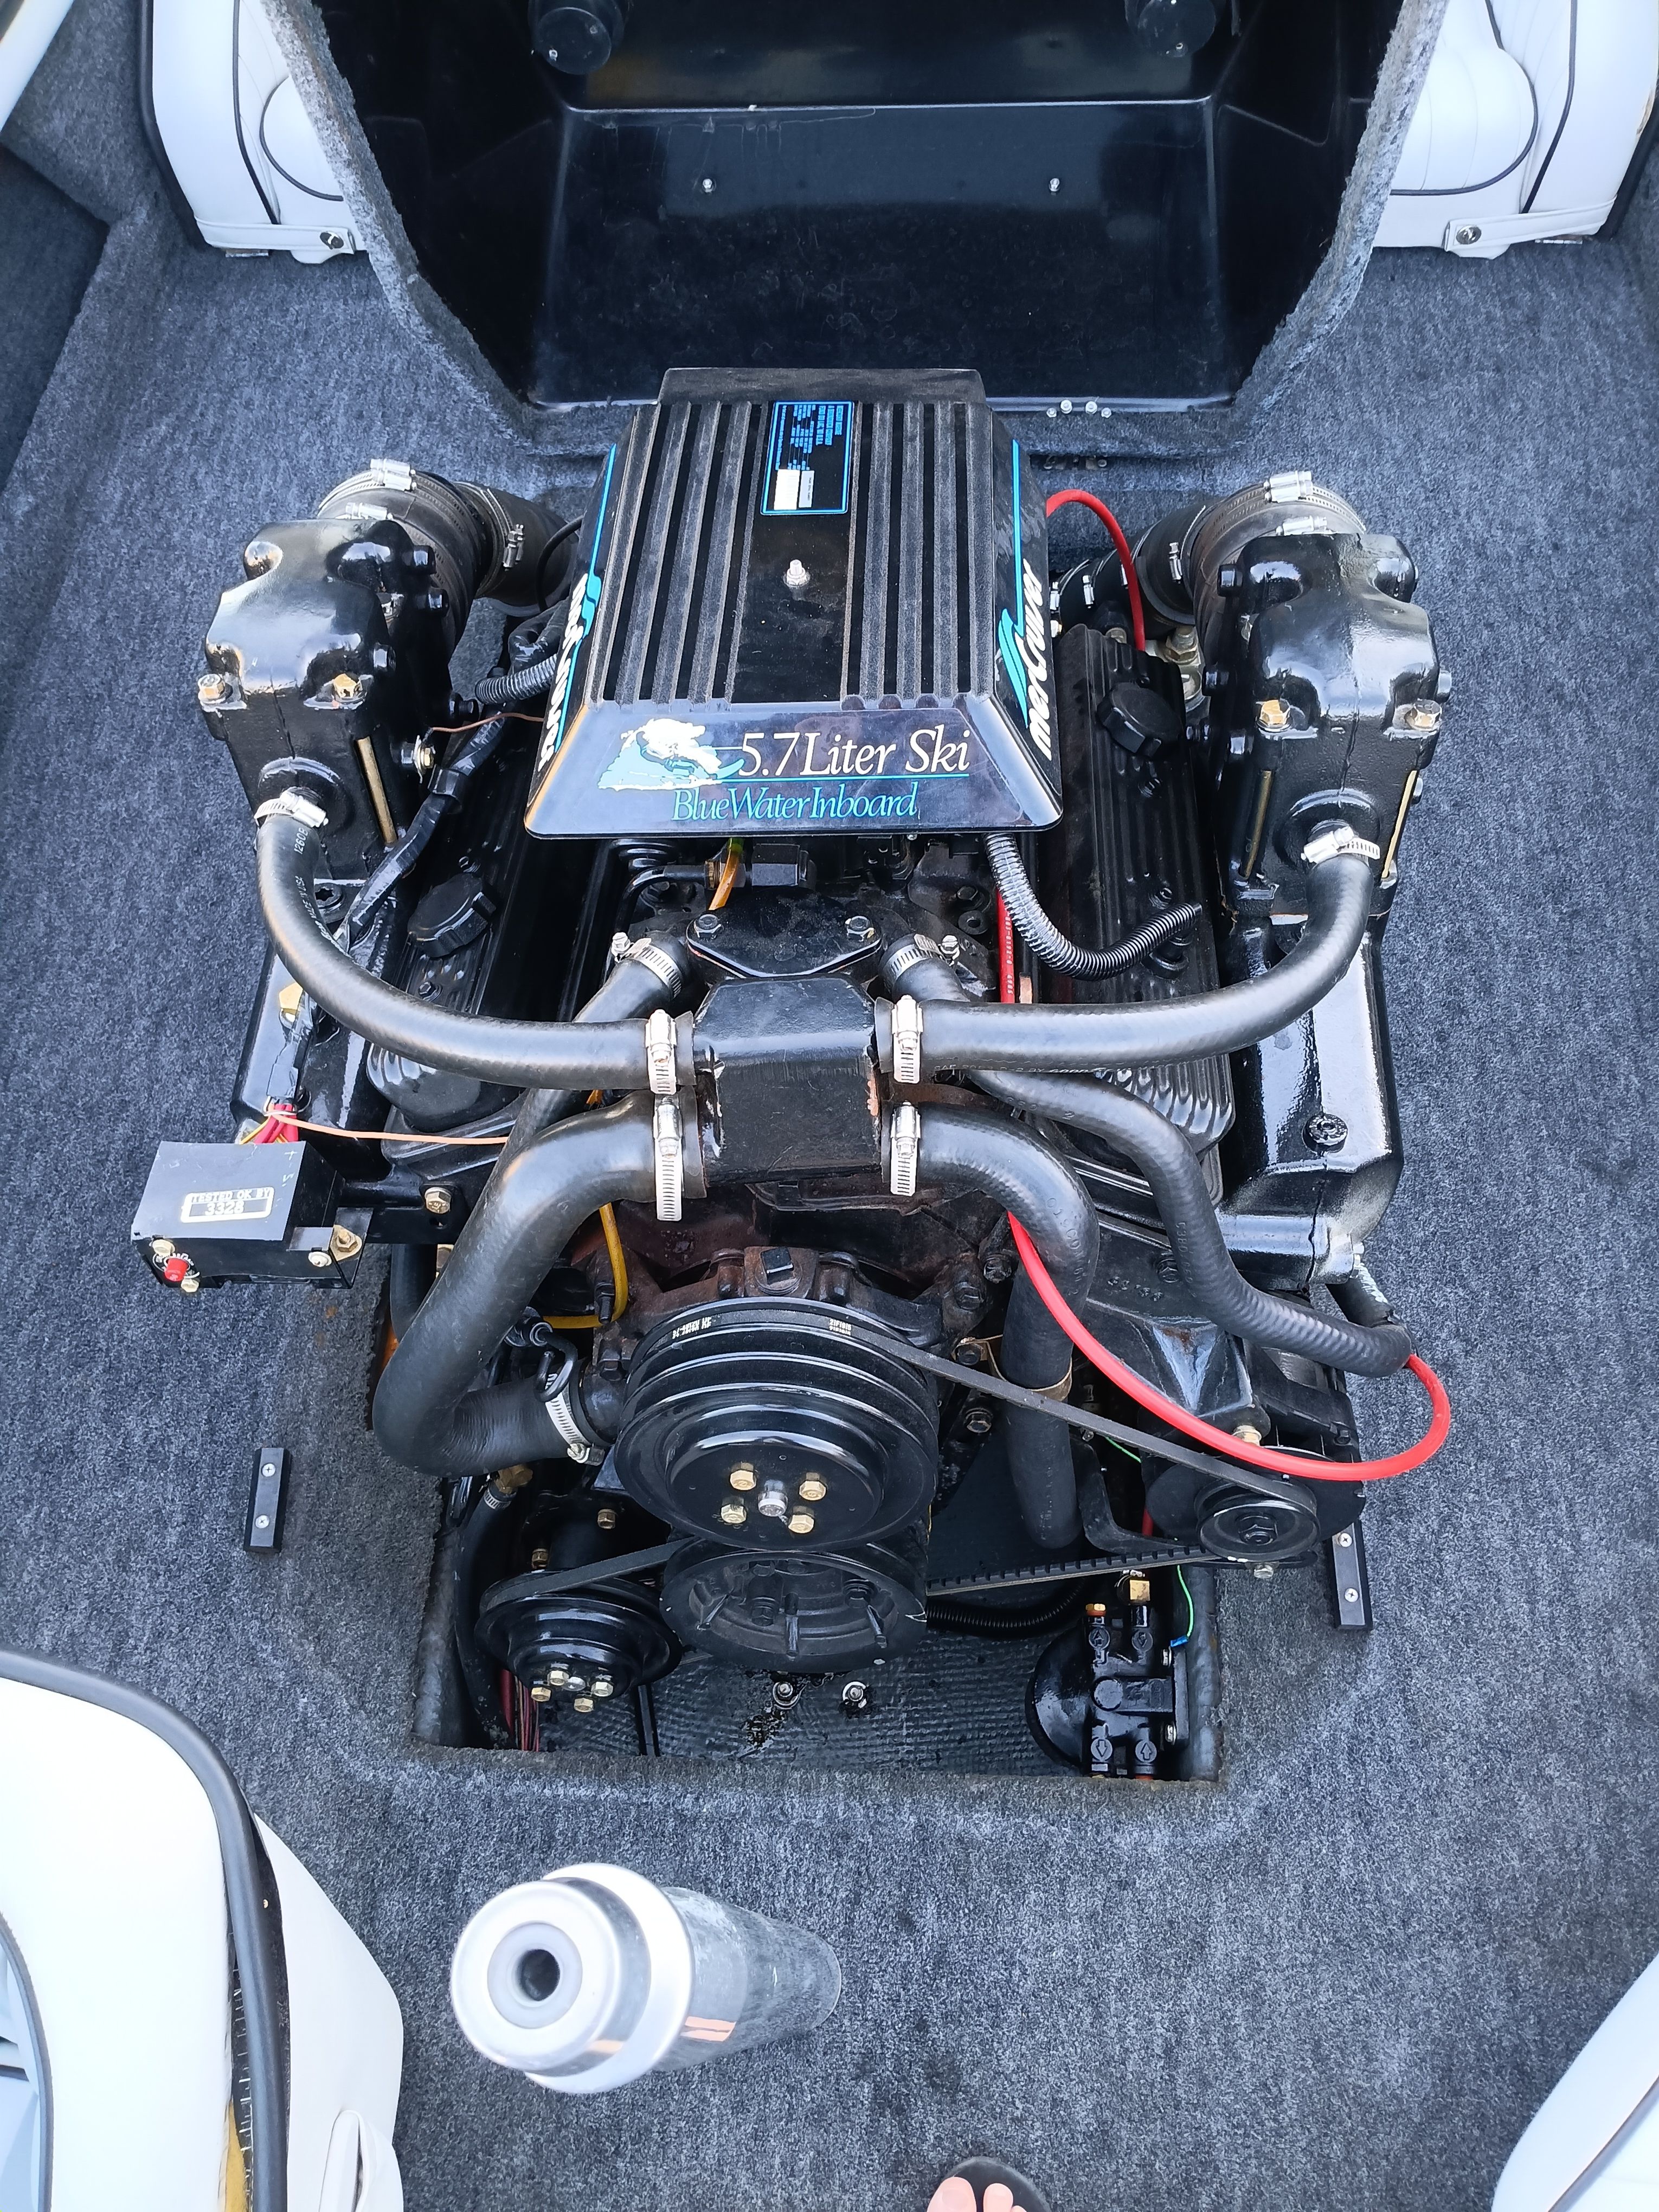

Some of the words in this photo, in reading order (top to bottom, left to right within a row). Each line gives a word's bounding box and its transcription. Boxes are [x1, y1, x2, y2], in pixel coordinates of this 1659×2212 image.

[905, 724, 970, 773] Ski
[191, 1191, 234, 1203] TESTED
[236, 1189, 253, 1200] OK
[256, 1187, 272, 1198] BY
[204, 1200, 245, 1216] 3328
